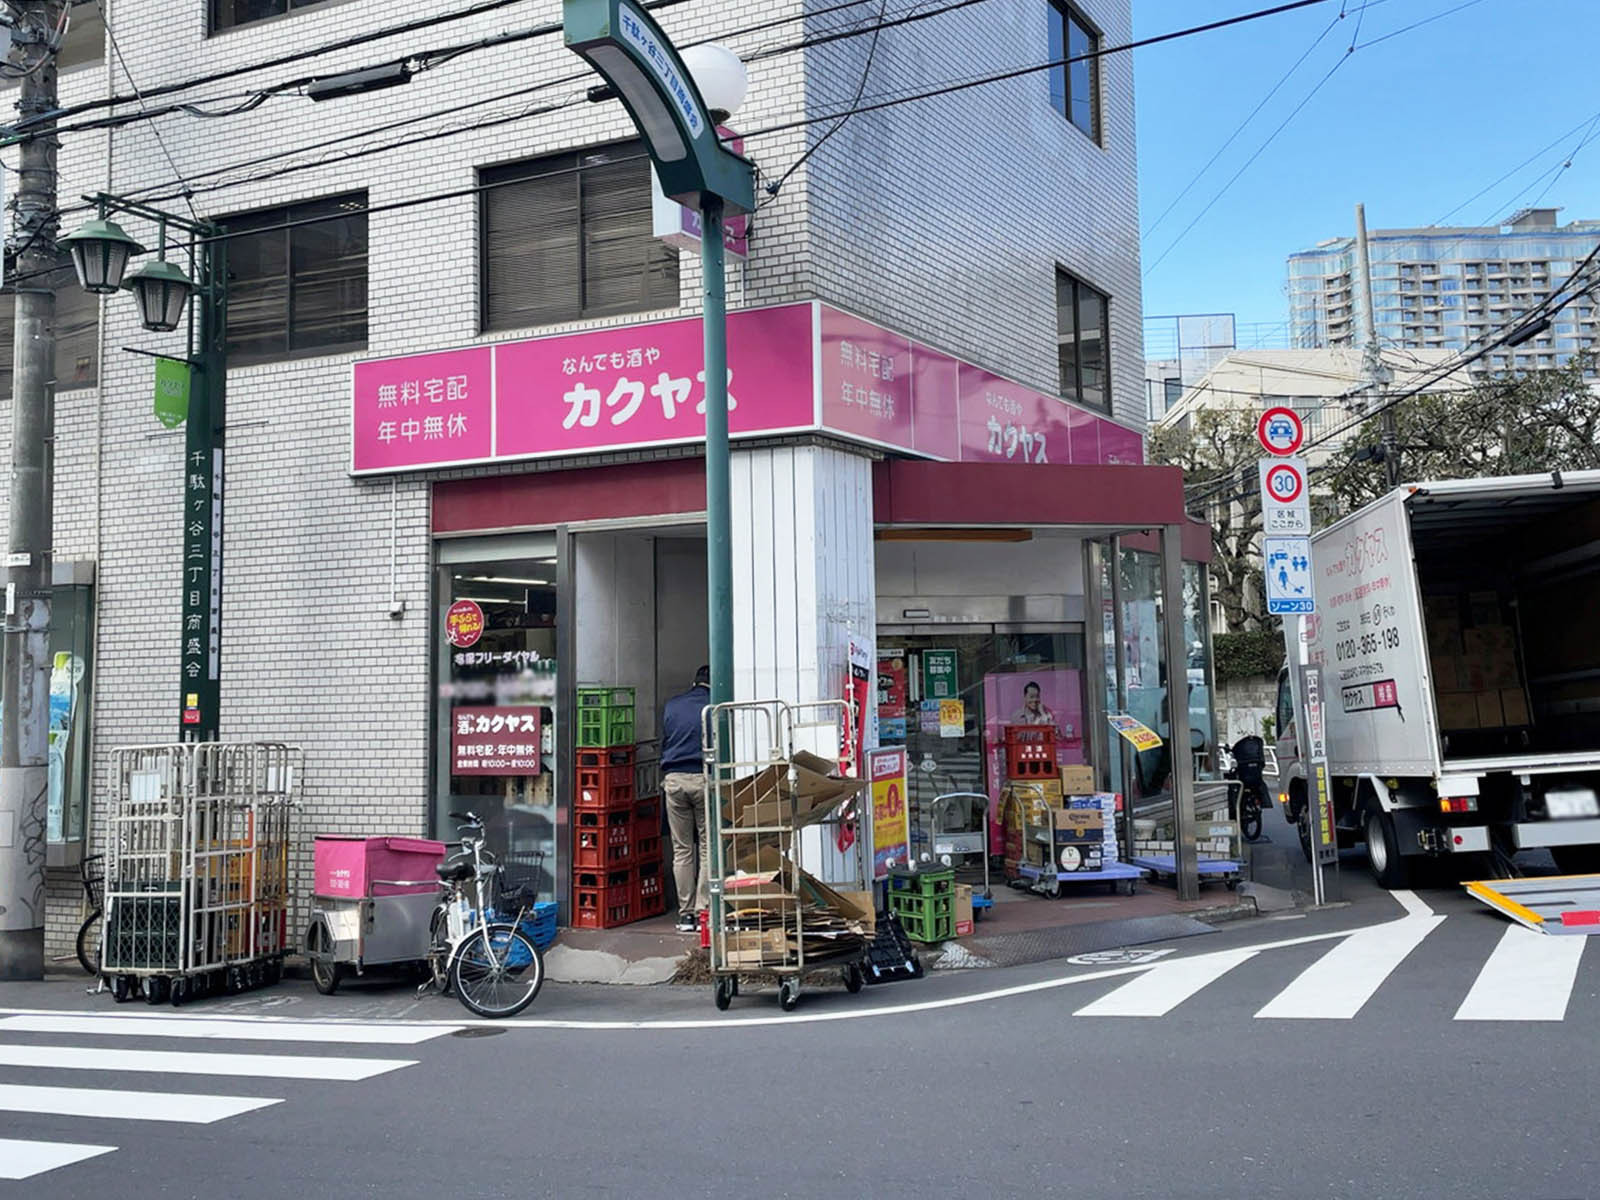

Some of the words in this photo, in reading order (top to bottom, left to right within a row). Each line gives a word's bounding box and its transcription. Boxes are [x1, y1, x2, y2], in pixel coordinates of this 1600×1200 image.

[562, 346, 661, 375] なんでも酒や
[377, 374, 469, 409] 無料宅配
[377, 413, 469, 445] 年中無休
[986, 415, 1049, 464] カクヤス
[1274, 474, 1295, 493] 30
[1271, 519, 1304, 529] ここから
[1276, 509, 1296, 519] 区域
[475, 714, 536, 734] カクヤス
